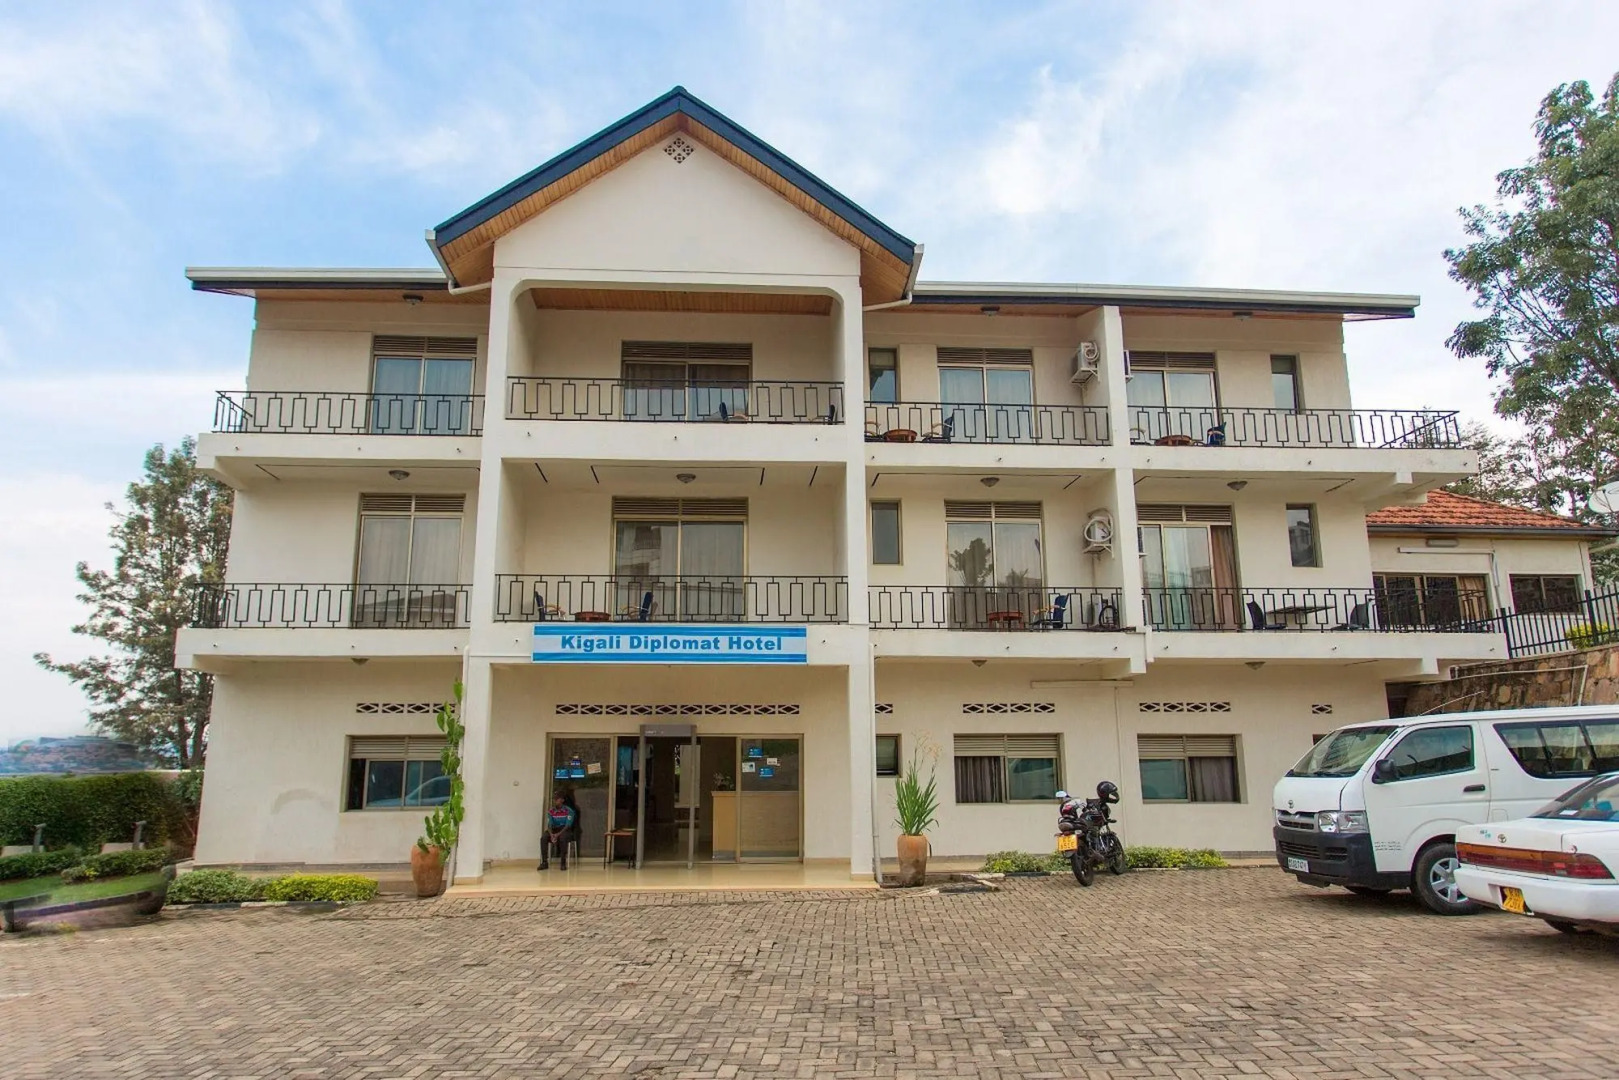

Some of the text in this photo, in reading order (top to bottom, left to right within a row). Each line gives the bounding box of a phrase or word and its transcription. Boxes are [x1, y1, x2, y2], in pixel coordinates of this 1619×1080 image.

[561, 635, 782, 652] Kigali Diplomat Hotel
